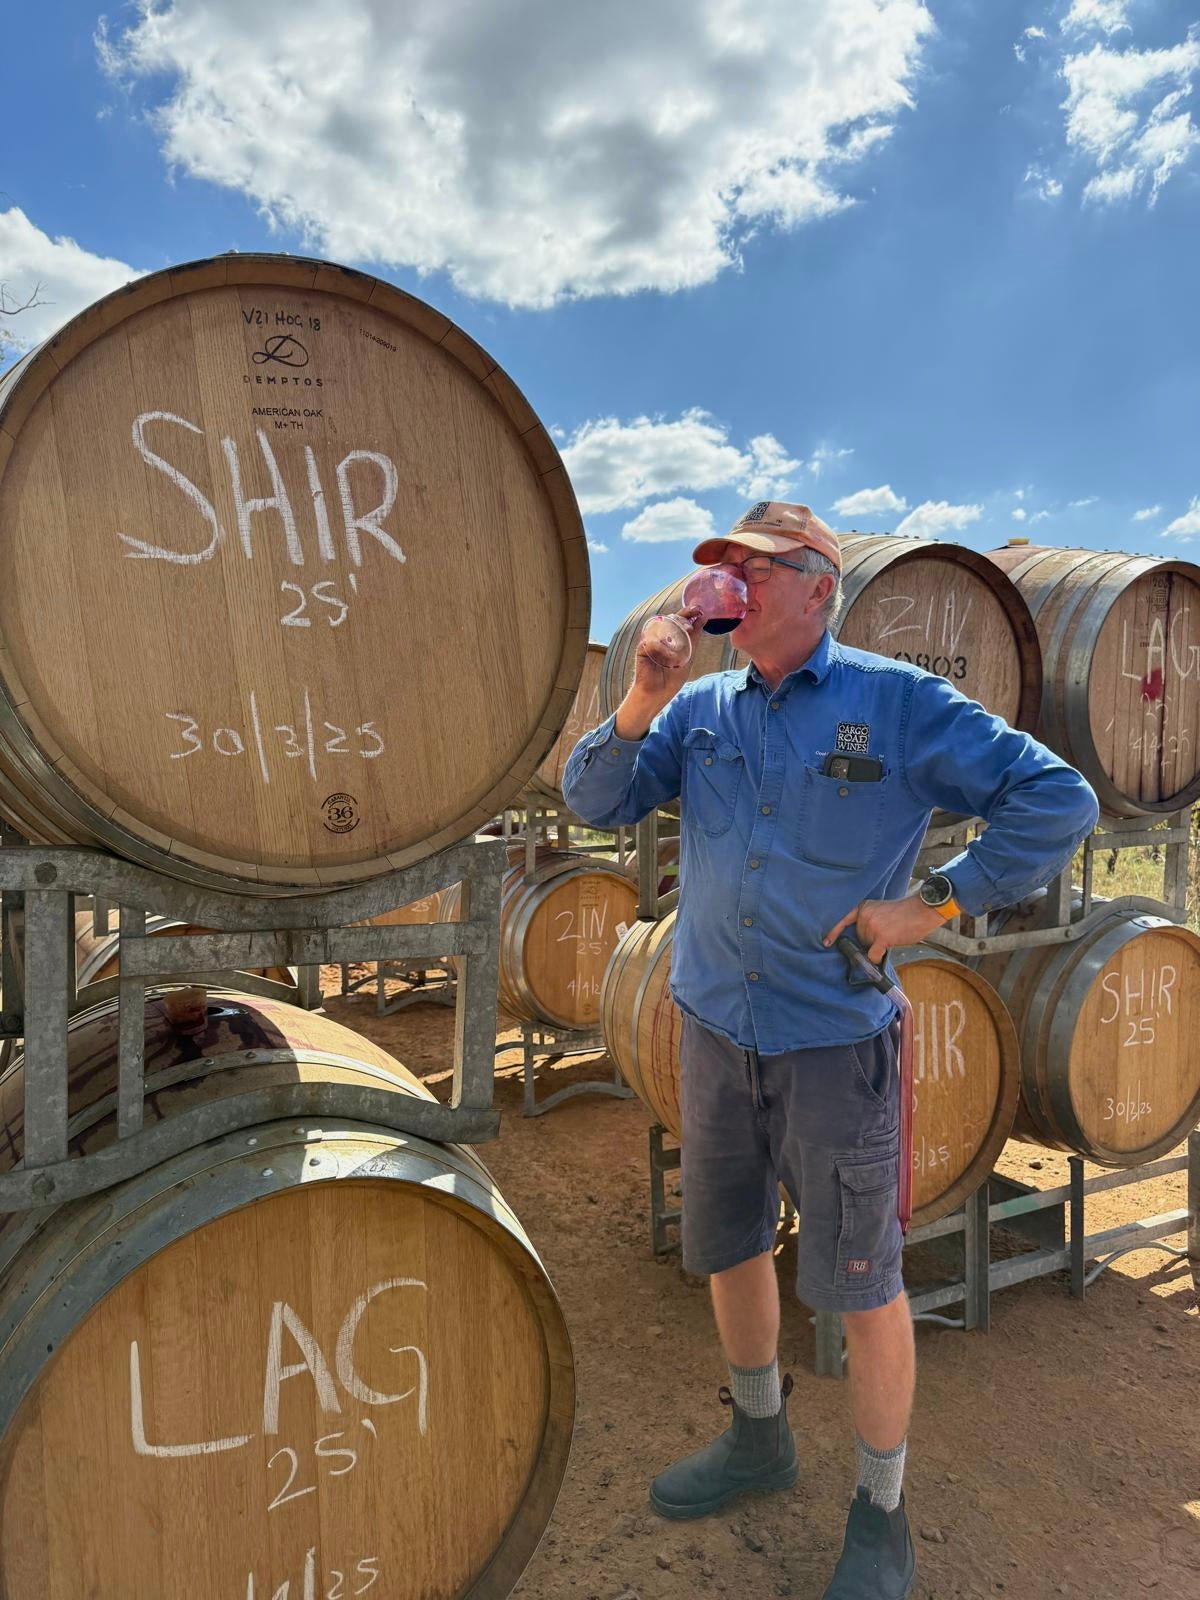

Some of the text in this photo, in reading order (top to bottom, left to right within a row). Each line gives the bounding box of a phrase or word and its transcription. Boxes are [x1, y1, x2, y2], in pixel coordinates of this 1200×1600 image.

[243, 375, 323, 387] DEMPTOS
[252, 407, 323, 418] AMERICAN OAK
[117, 410, 407, 566] SHIR
[1122, 607, 1200, 686] LAG
[838, 724, 868, 735] CARGO
[838, 733, 867, 743] ROAD
[838, 741, 867, 752] WINES
[327, 806, 354, 821] 36
[1100, 965, 1176, 1024] SHIR
[914, 1000, 966, 1081] HIR
[130, 1277, 428, 1457] LAG
